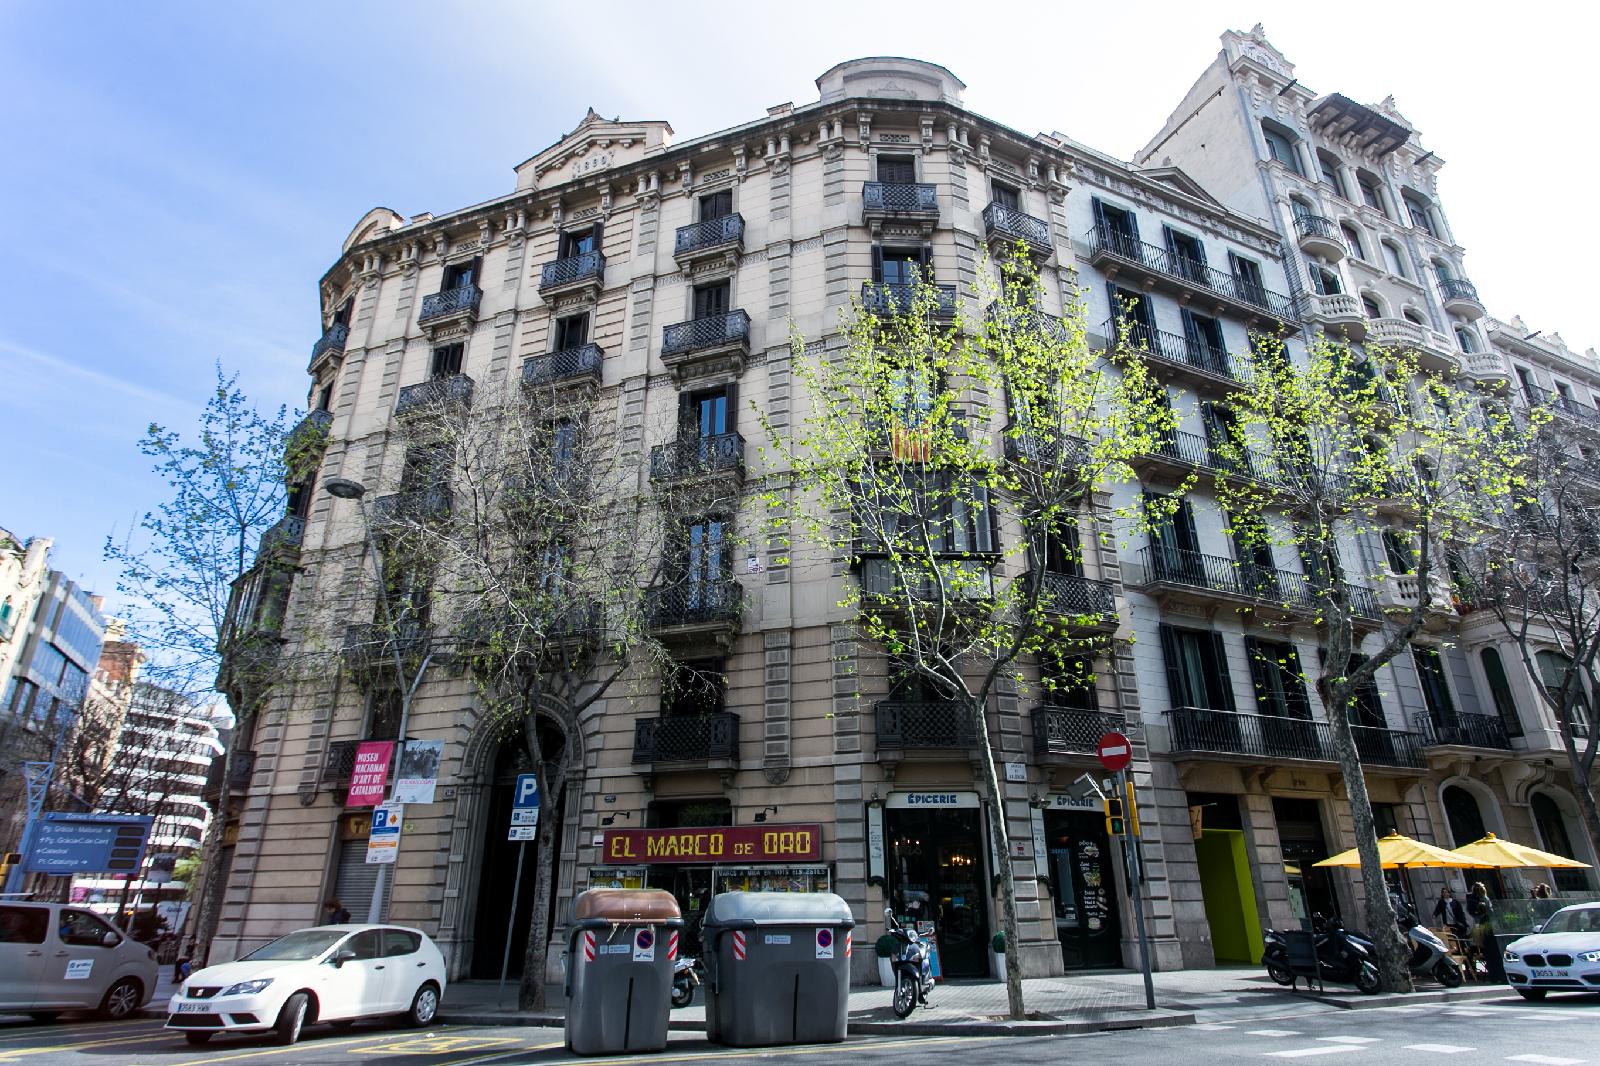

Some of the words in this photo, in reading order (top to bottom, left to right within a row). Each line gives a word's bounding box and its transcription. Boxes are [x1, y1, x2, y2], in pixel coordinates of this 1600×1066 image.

[357, 753, 379, 763] MUSEU
[355, 763, 386, 773] NACIONAL
[353, 774, 372, 784] D'ART
[373, 774, 382, 784] DE
[350, 784, 384, 796] CATALUNYA
[519, 778, 537, 804] P
[907, 793, 957, 804] ÉPICERIE
[375, 812, 384, 826] P
[611, 837, 636, 858] EL
[647, 834, 724, 857] MARCO
[734, 843, 754, 855] DE
[764, 831, 811, 855] ORO
